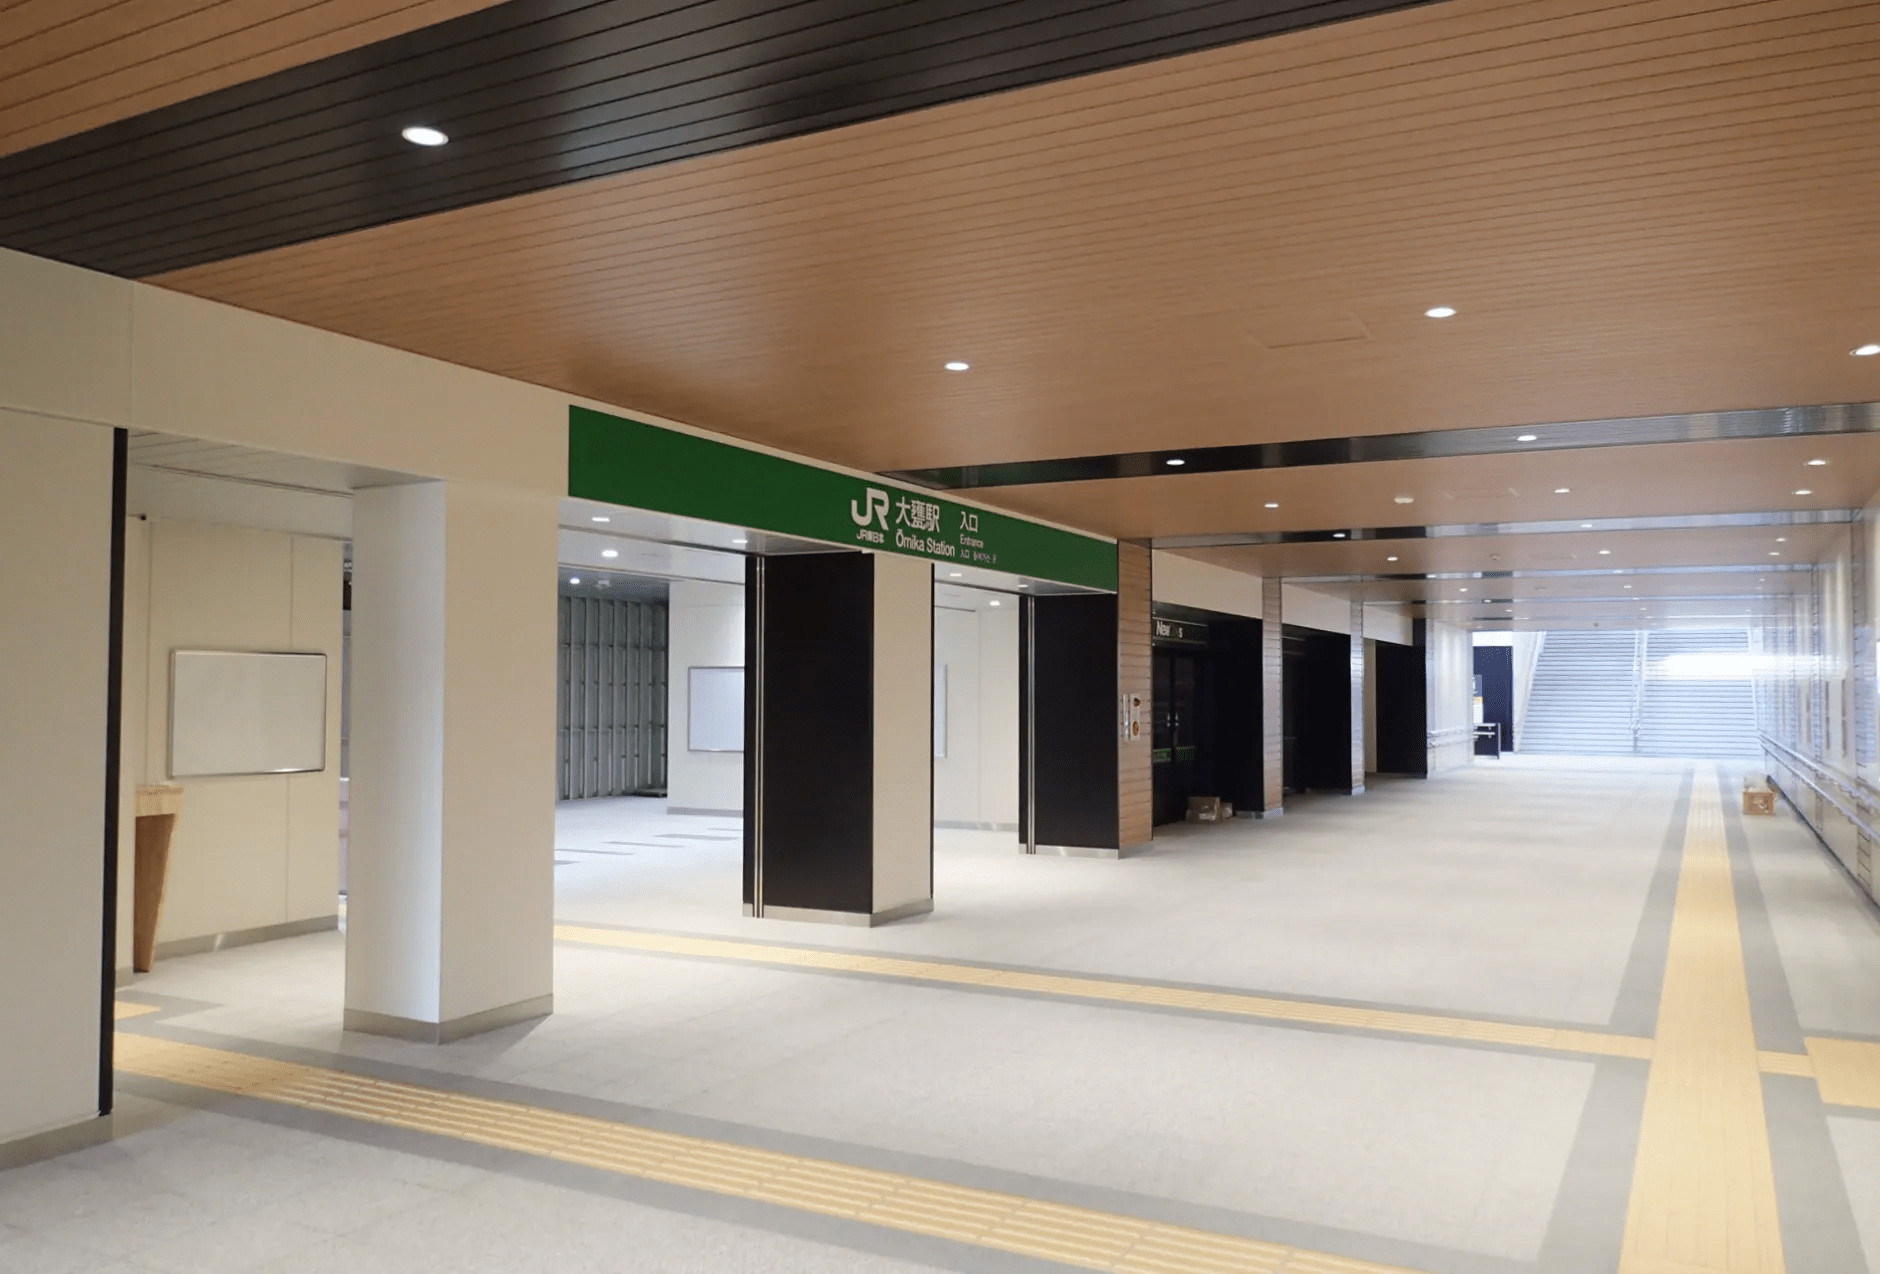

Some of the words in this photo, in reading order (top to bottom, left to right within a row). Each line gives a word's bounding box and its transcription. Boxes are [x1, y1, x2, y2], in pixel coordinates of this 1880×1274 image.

[851, 487, 889, 531] JR
[895, 496, 940, 533] 大甕駅
[960, 511, 979, 533] 入口
[926, 537, 955, 558] Station
[960, 533, 984, 549] Entrance
